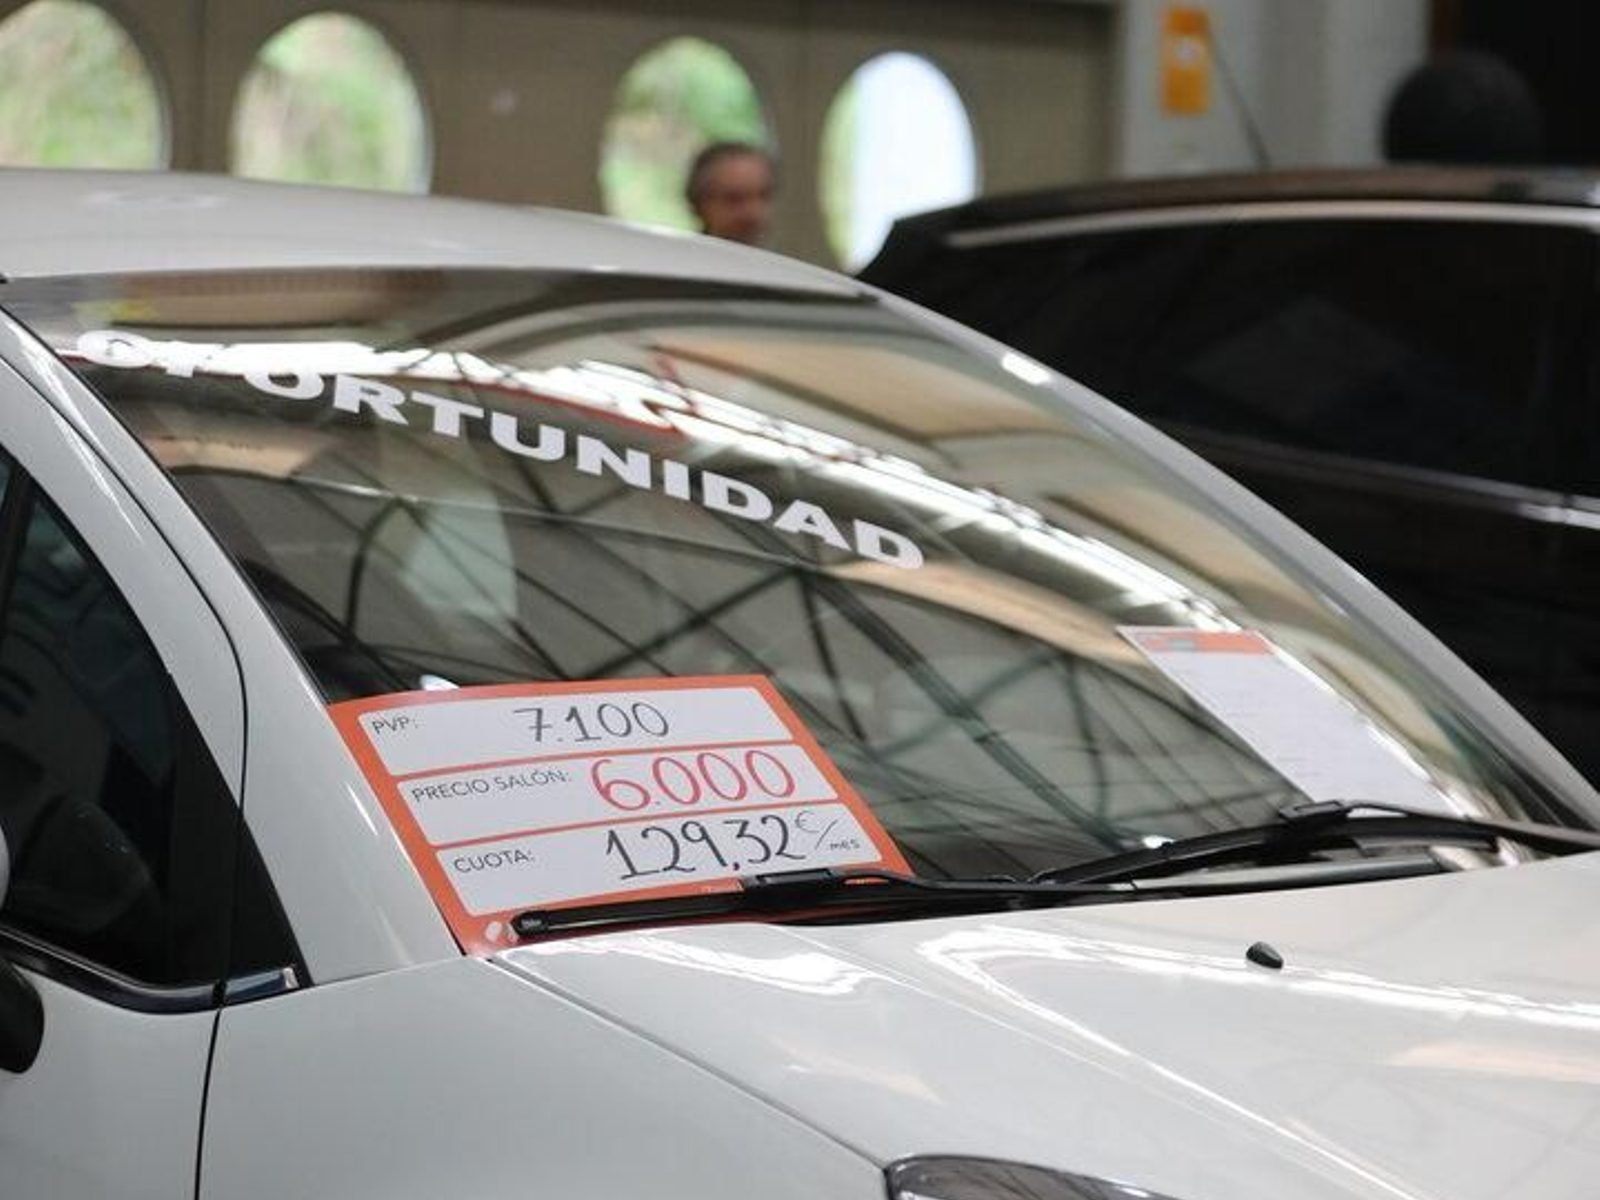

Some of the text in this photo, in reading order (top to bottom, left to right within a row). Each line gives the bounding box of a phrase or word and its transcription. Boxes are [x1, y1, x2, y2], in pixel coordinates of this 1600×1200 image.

[371, 715, 419, 734] PVP:
[514, 702, 669, 742] 7.100
[411, 768, 572, 803] PRECIO SALÓN:
[591, 750, 796, 811] 6.000
[453, 849, 536, 874] CUOTA:
